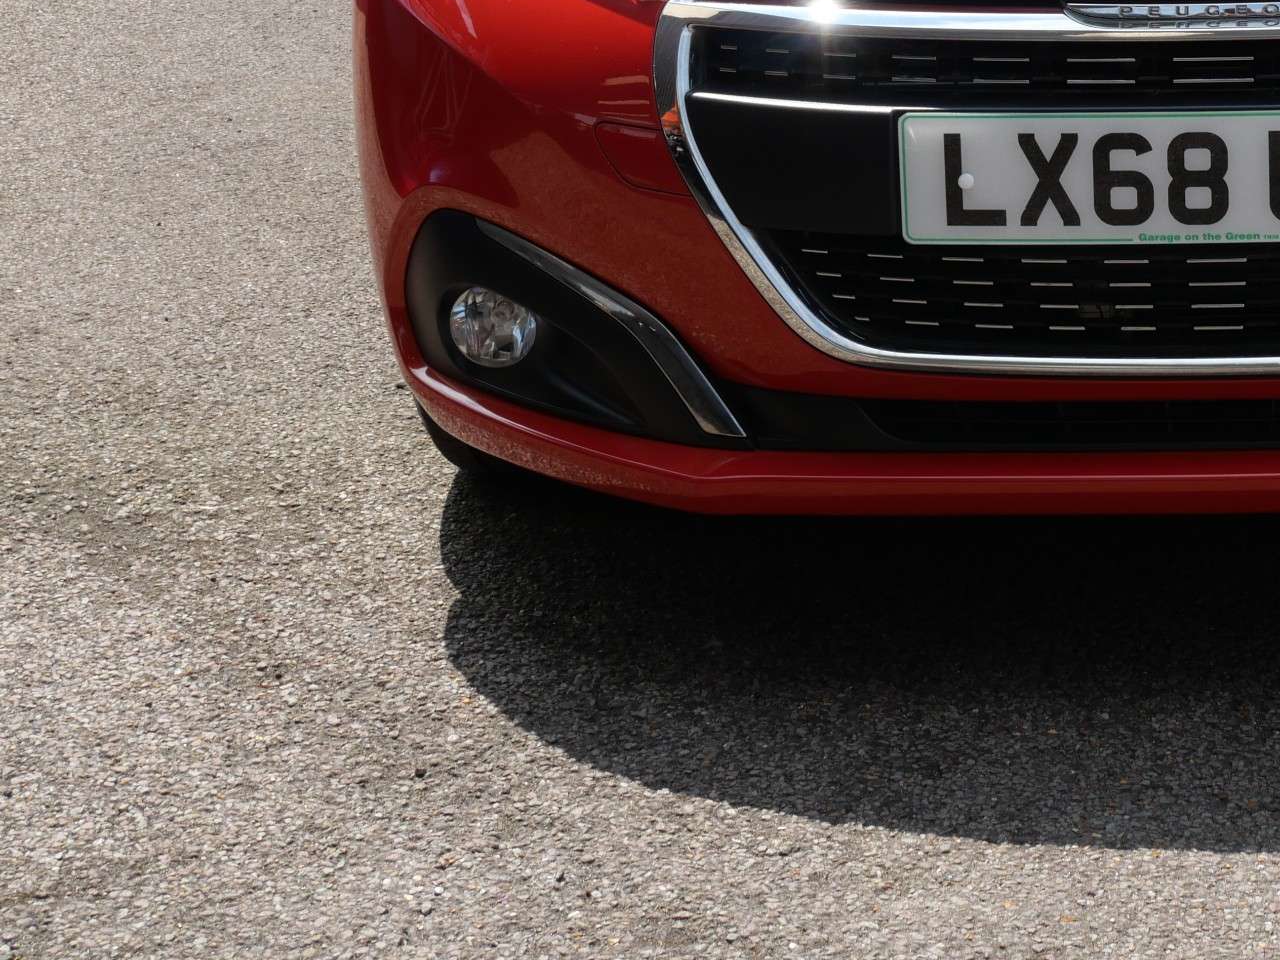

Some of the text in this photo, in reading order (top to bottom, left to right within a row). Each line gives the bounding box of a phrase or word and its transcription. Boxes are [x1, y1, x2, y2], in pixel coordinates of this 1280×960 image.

[943, 132, 1229, 227] LX68
[1138, 232, 1181, 243] Garage
[1184, 233, 1200, 242] on
[1202, 232, 1223, 242] the
[1225, 231, 1262, 241] Green
